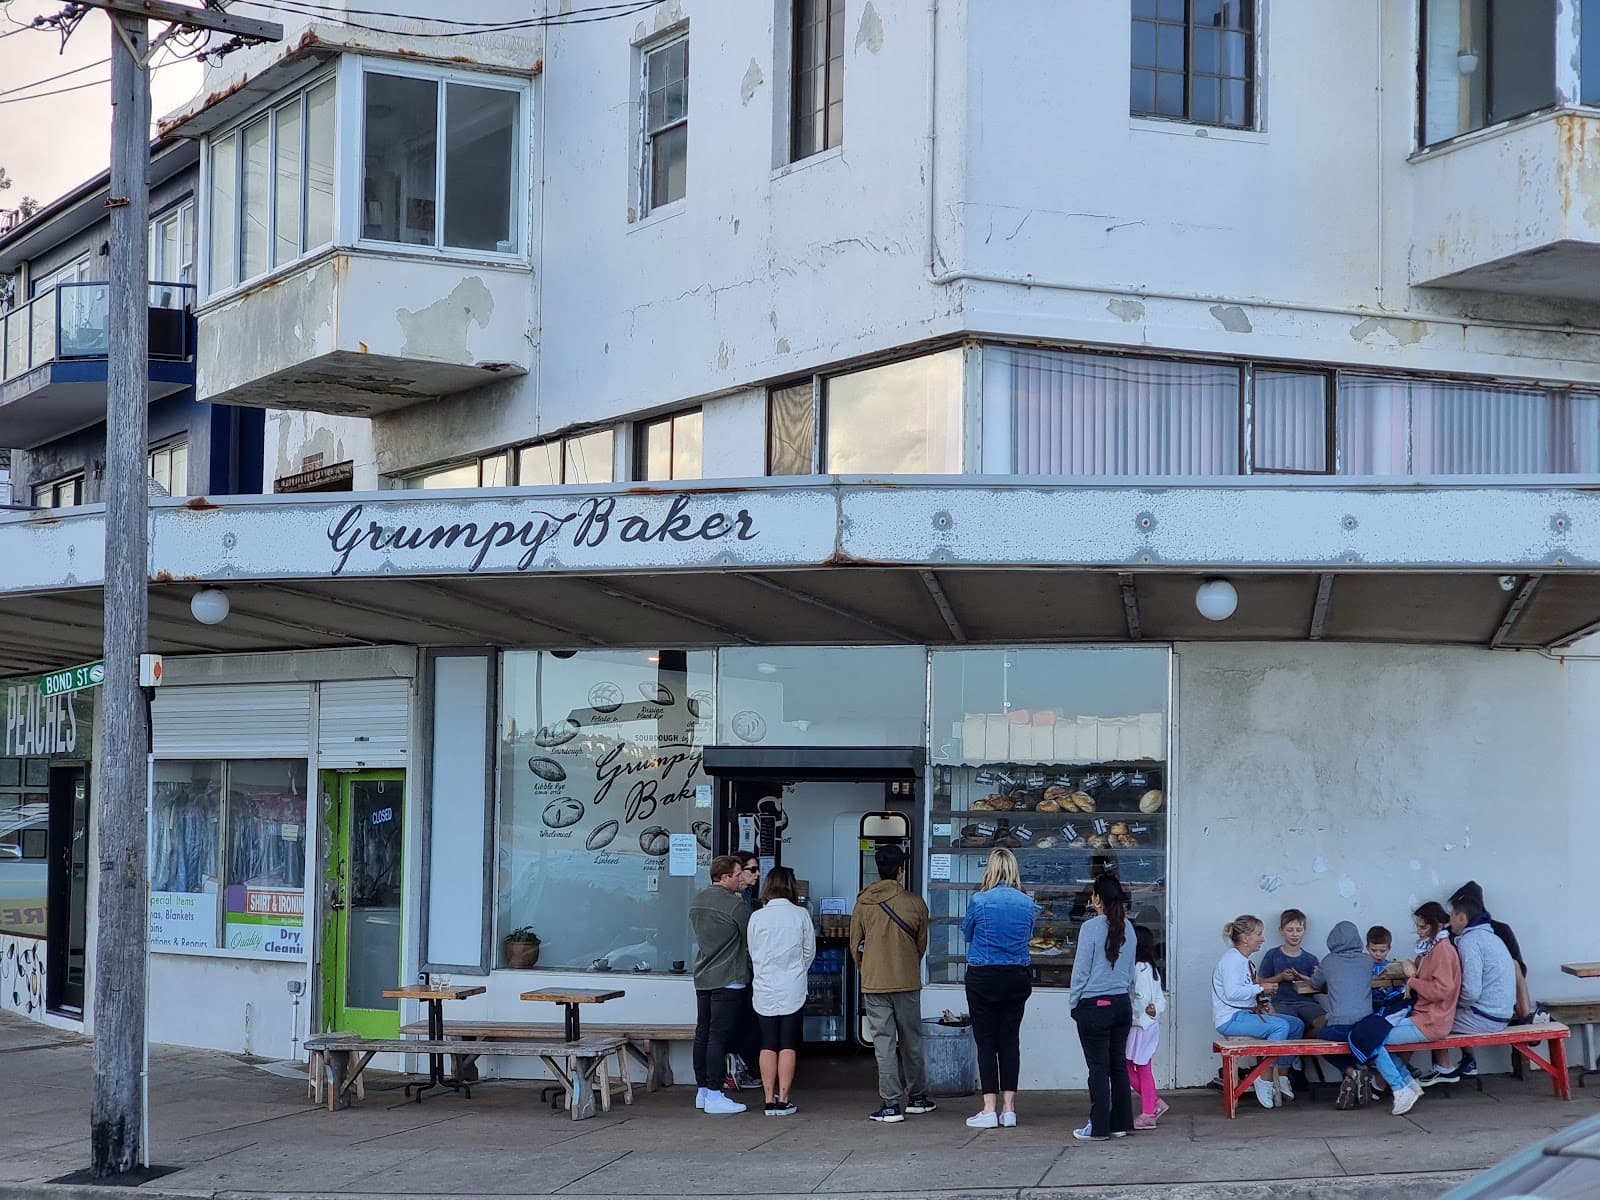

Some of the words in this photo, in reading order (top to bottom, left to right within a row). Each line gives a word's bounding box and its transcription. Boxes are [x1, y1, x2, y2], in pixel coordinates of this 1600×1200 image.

[327, 504, 577, 576] Grumpy
[573, 493, 761, 547] Baker
[46, 672, 73, 694] BOND
[77, 667, 89, 686] ST
[6, 684, 76, 756] PEACHES
[635, 733, 679, 742] SOURDOUGH
[594, 742, 703, 804] Grumpy
[625, 780, 697, 824] Bak
[372, 807, 393, 825] CLOSED
[165, 909, 194, 921] Blankets
[250, 894, 271, 911] SHIRT
[272, 895, 277, 912] &
[278, 896, 304, 913] IRONIN
[280, 928, 301, 944] Dry
